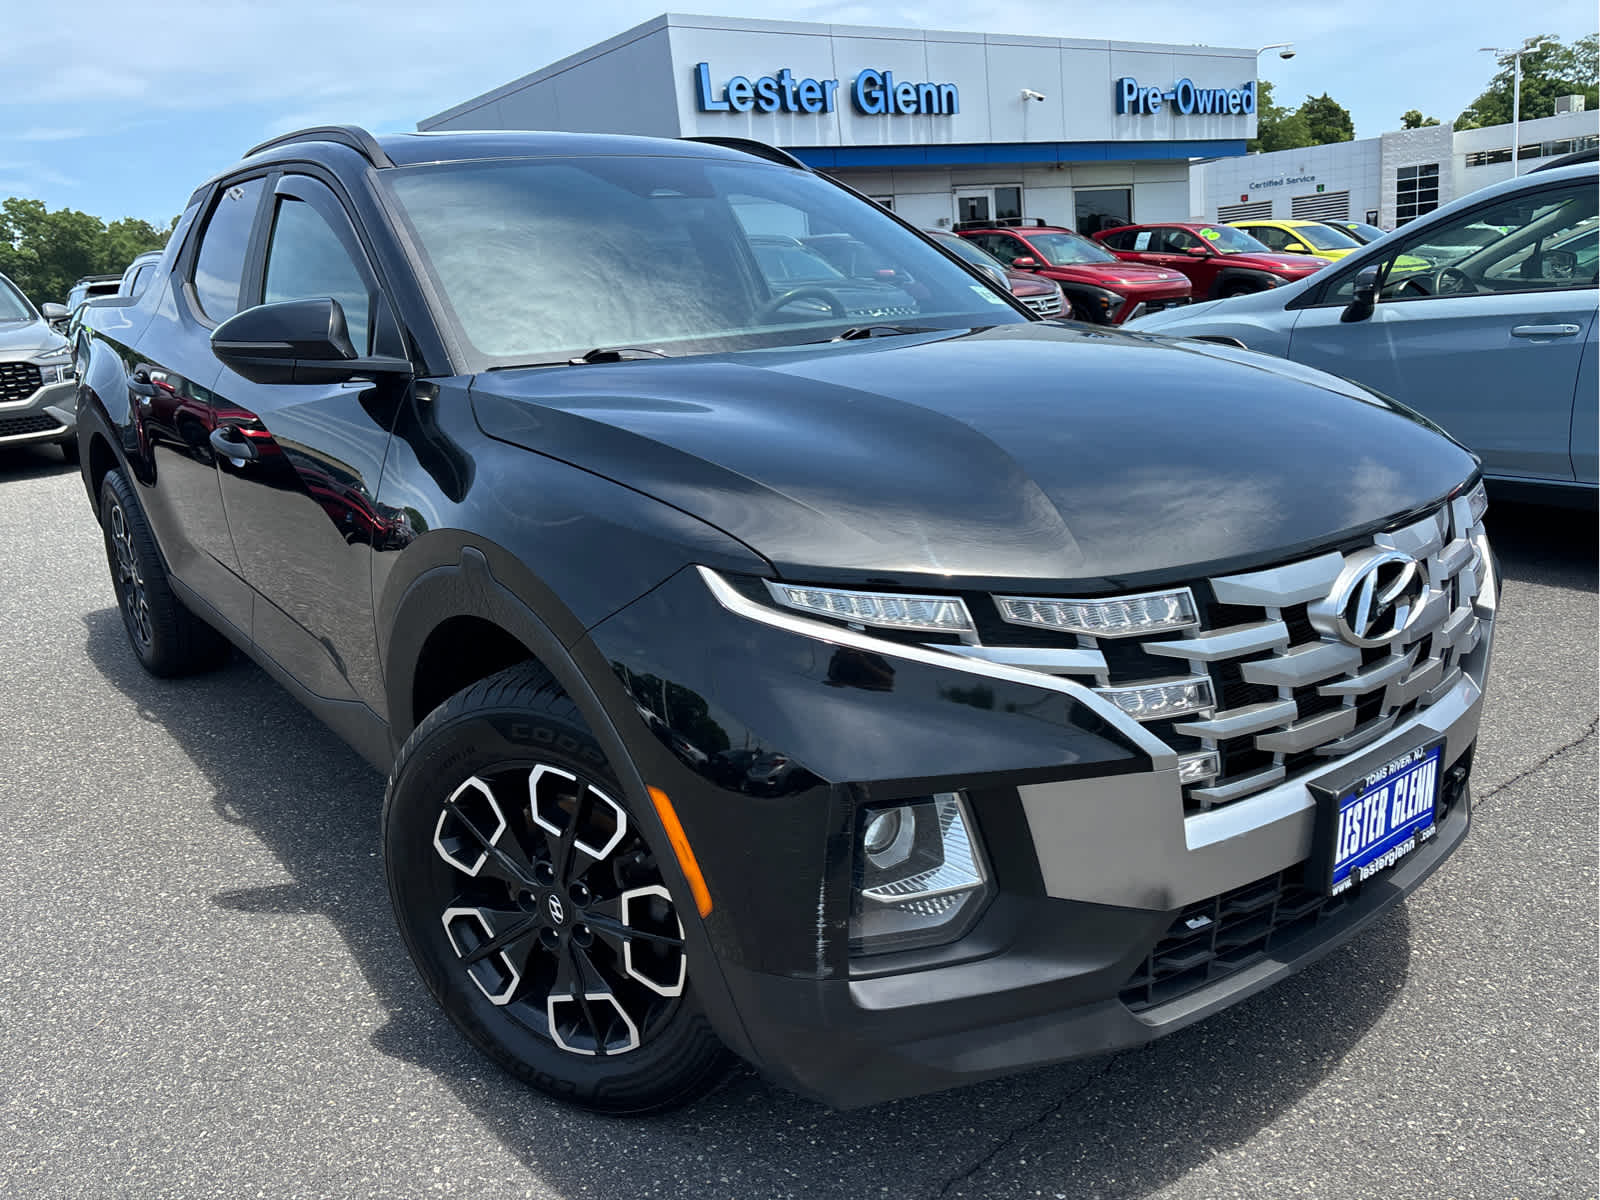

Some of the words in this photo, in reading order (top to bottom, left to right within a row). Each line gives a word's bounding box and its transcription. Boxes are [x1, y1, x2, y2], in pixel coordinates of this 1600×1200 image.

[695, 61, 839, 113] Lester
[850, 68, 960, 116] Glenn
[1116, 77, 1256, 116] Pre-Owned
[1249, 178, 1284, 190] Certified
[1286, 174, 1316, 185] Service
[1365, 767, 1388, 787] TOMS
[1335, 787, 1389, 865] LESTER
[1391, 760, 1437, 829] GLENN
